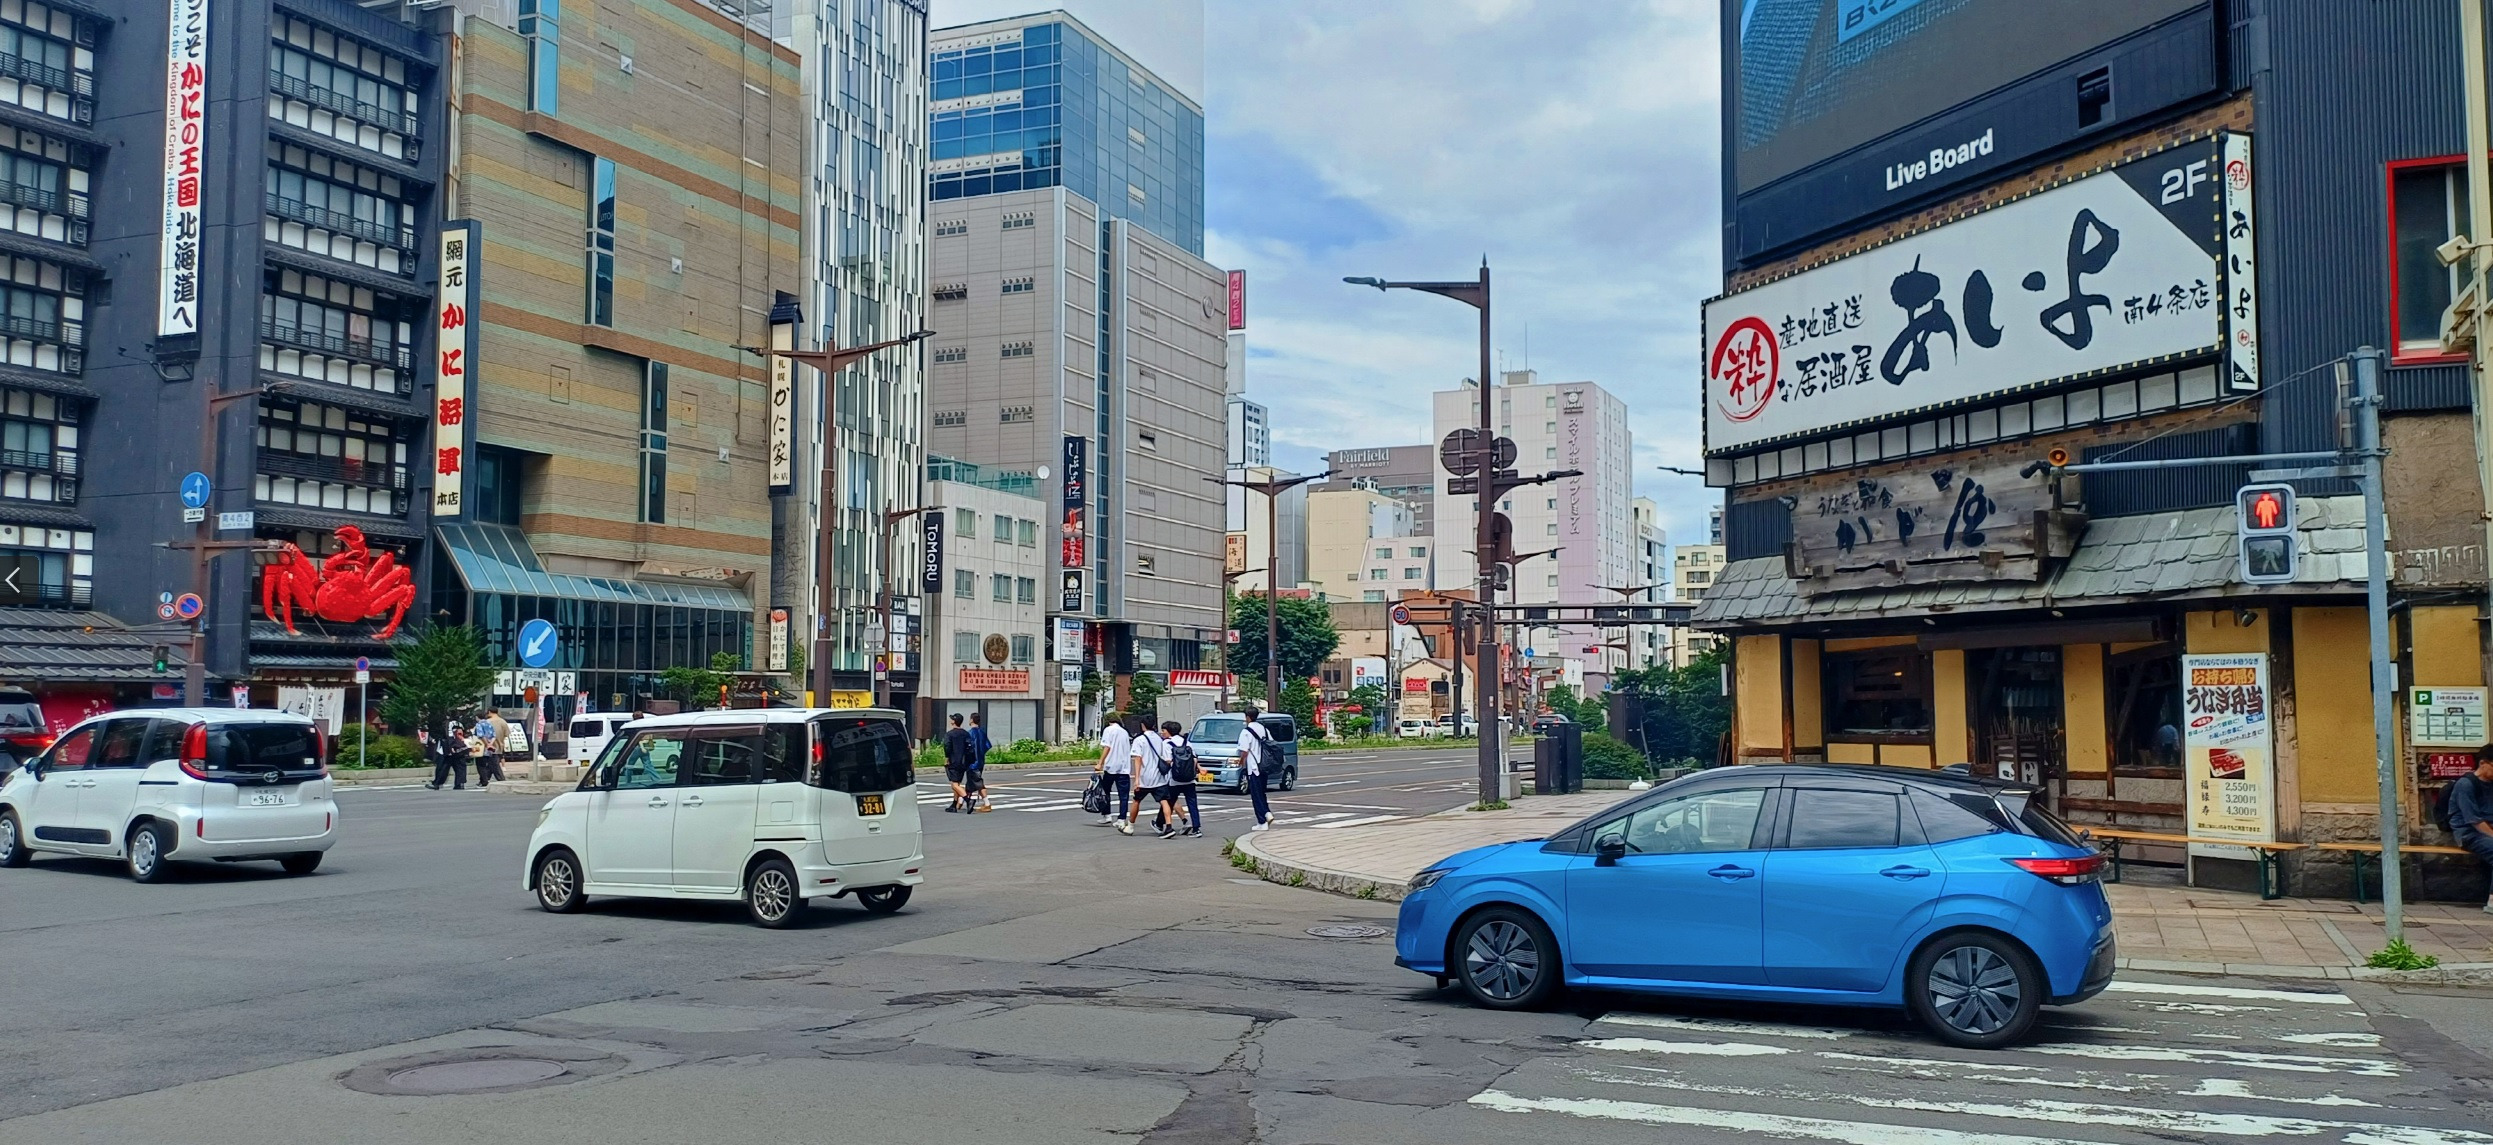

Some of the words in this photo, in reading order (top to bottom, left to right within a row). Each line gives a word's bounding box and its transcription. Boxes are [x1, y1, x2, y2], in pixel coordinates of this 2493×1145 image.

[171, 40, 179, 58] the
[172, 25, 180, 36] to
[169, 62, 179, 116] Kingdom
[178, 62, 203, 207] かにの王国
[1886, 165, 1926, 191] Live
[1930, 128, 1993, 175] Board
[2161, 159, 2207, 205] 2F
[165, 178, 175, 235] Hokkaido
[173, 211, 198, 328] 北海道へ
[446, 240, 463, 288] 網元
[1880, 208, 2119, 385] あいよ
[2123, 279, 2210, 325] 南4条店
[1779, 294, 1866, 350] 産地直送
[438, 303, 464, 476] かに将軍
[1778, 345, 1875, 403] な居酒屋
[773, 387, 790, 466] かに家
[772, 473, 788, 481] 本店
[1340, 448, 1390, 464] Fairfield
[436, 491, 459, 506] 本店
[926, 524, 938, 581] TOMORU
[1396, 610, 1406, 620] 50
[2186, 685, 2264, 714] うなぎ弁当
[2192, 668, 2255, 685] お持ち帰り
[2419, 694, 2428, 702] P
[2225, 782, 2256, 792] 2,550円
[2225, 794, 2256, 804] 3,200円
[2226, 806, 2257, 815] 4,300円
